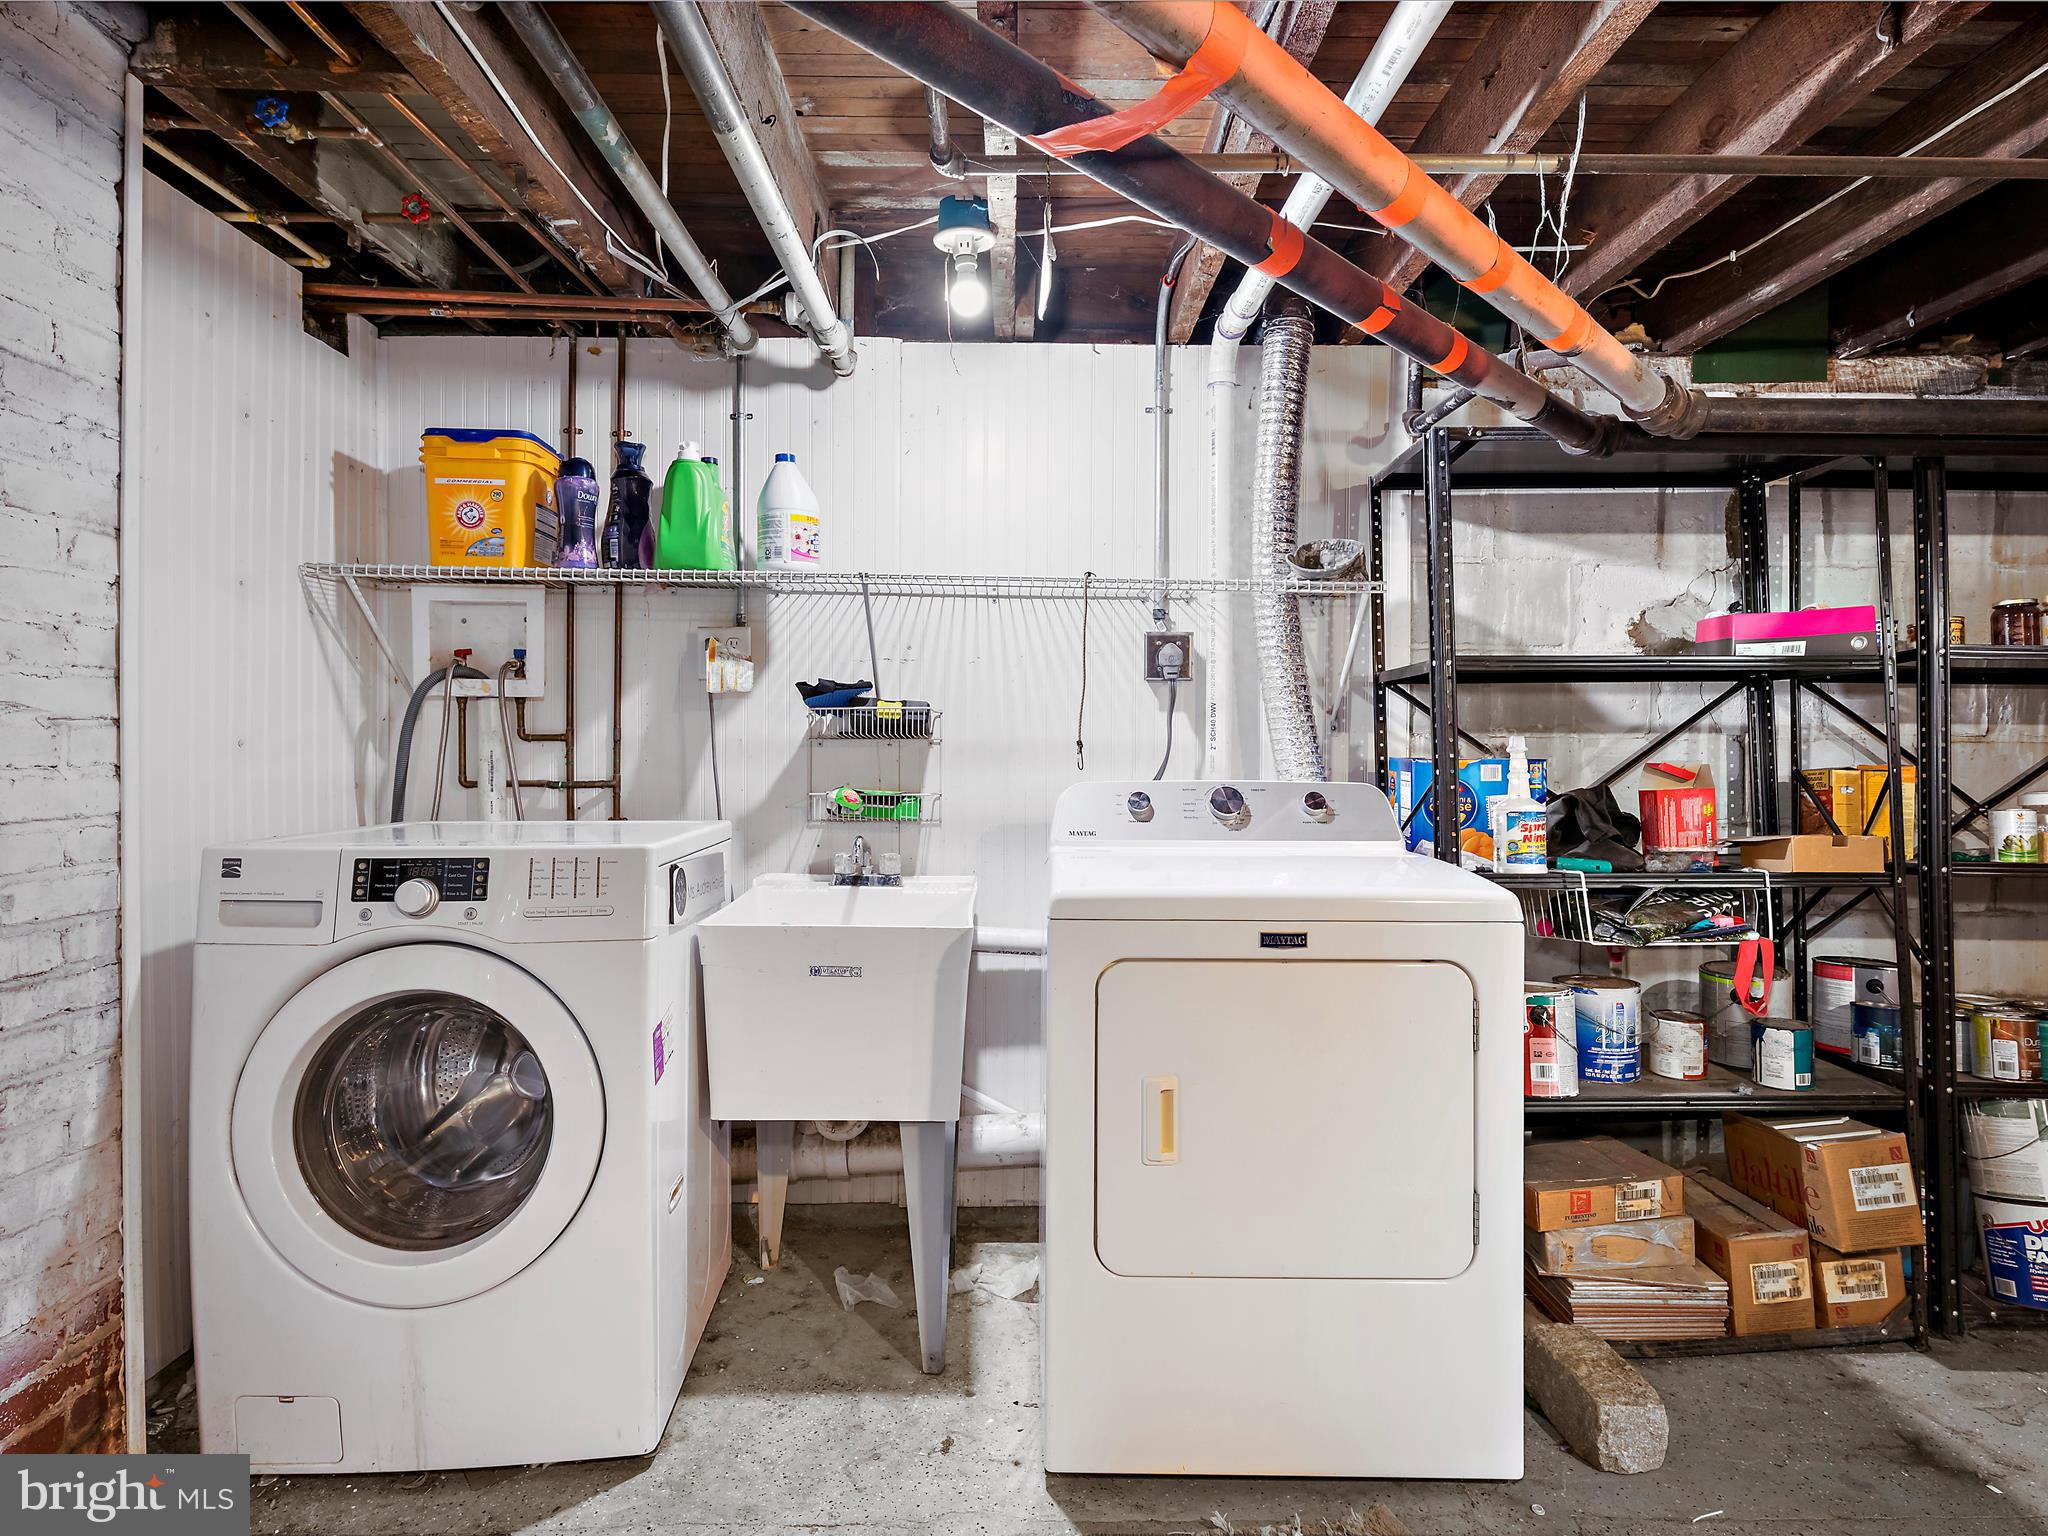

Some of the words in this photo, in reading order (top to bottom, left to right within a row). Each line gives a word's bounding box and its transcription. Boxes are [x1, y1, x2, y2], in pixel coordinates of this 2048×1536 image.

[578, 490, 597, 505] Down
[1520, 823, 1546, 833] Spra
[1263, 936, 1306, 945] MAYTAG
[1734, 1149, 1822, 1210] daltile
[1565, 1212, 1596, 1221] FLORENTINO
